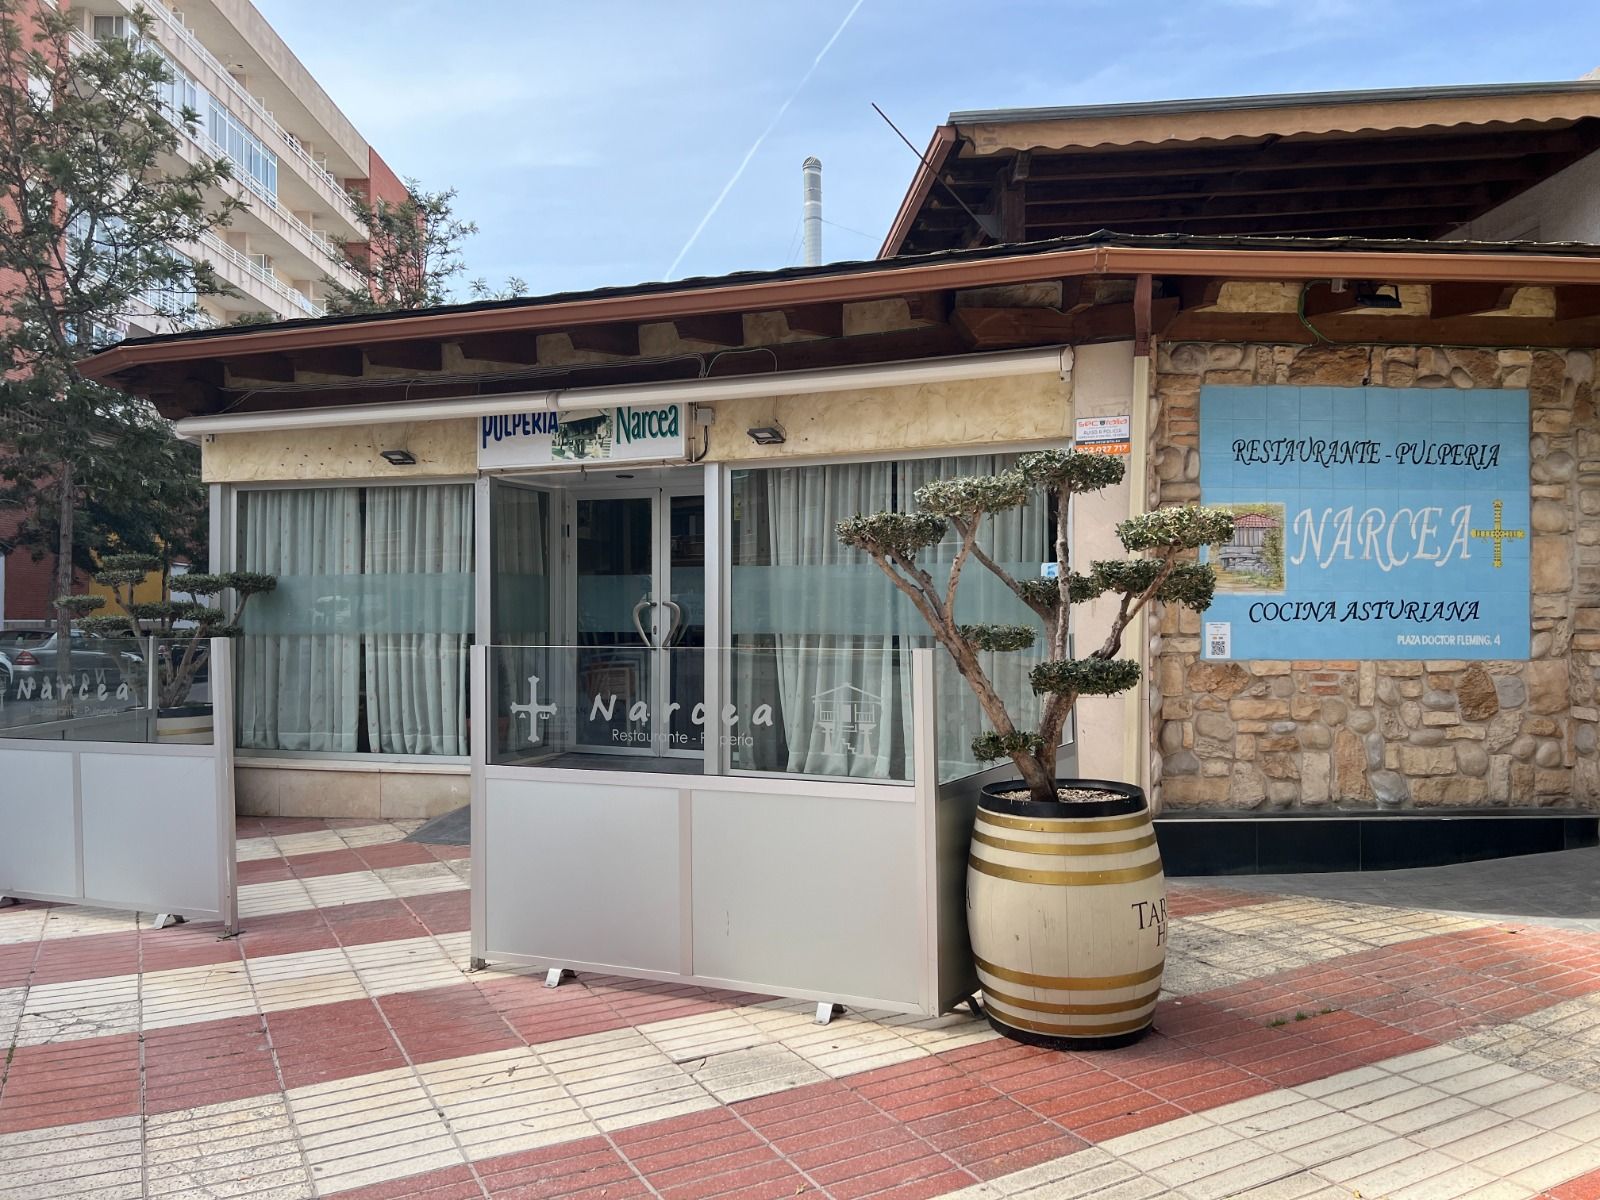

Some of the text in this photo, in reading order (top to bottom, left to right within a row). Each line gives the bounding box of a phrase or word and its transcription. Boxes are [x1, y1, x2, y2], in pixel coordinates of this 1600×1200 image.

[616, 404, 679, 444] Narcea
[1232, 437, 1381, 468] RESTAURANTE
[1395, 440, 1500, 470] PULPERIA
[1290, 504, 1473, 572] NARCEA
[1249, 599, 1480, 623] COCINA ASTURIANA
[1397, 634, 1421, 646] PLAZA
[1422, 634, 1456, 646] DOCTOR
[1494, 634, 1501, 646] 4
[17, 679, 129, 701] Narcea
[589, 692, 774, 727] Narcea
[612, 728, 688, 744] Restaurante
